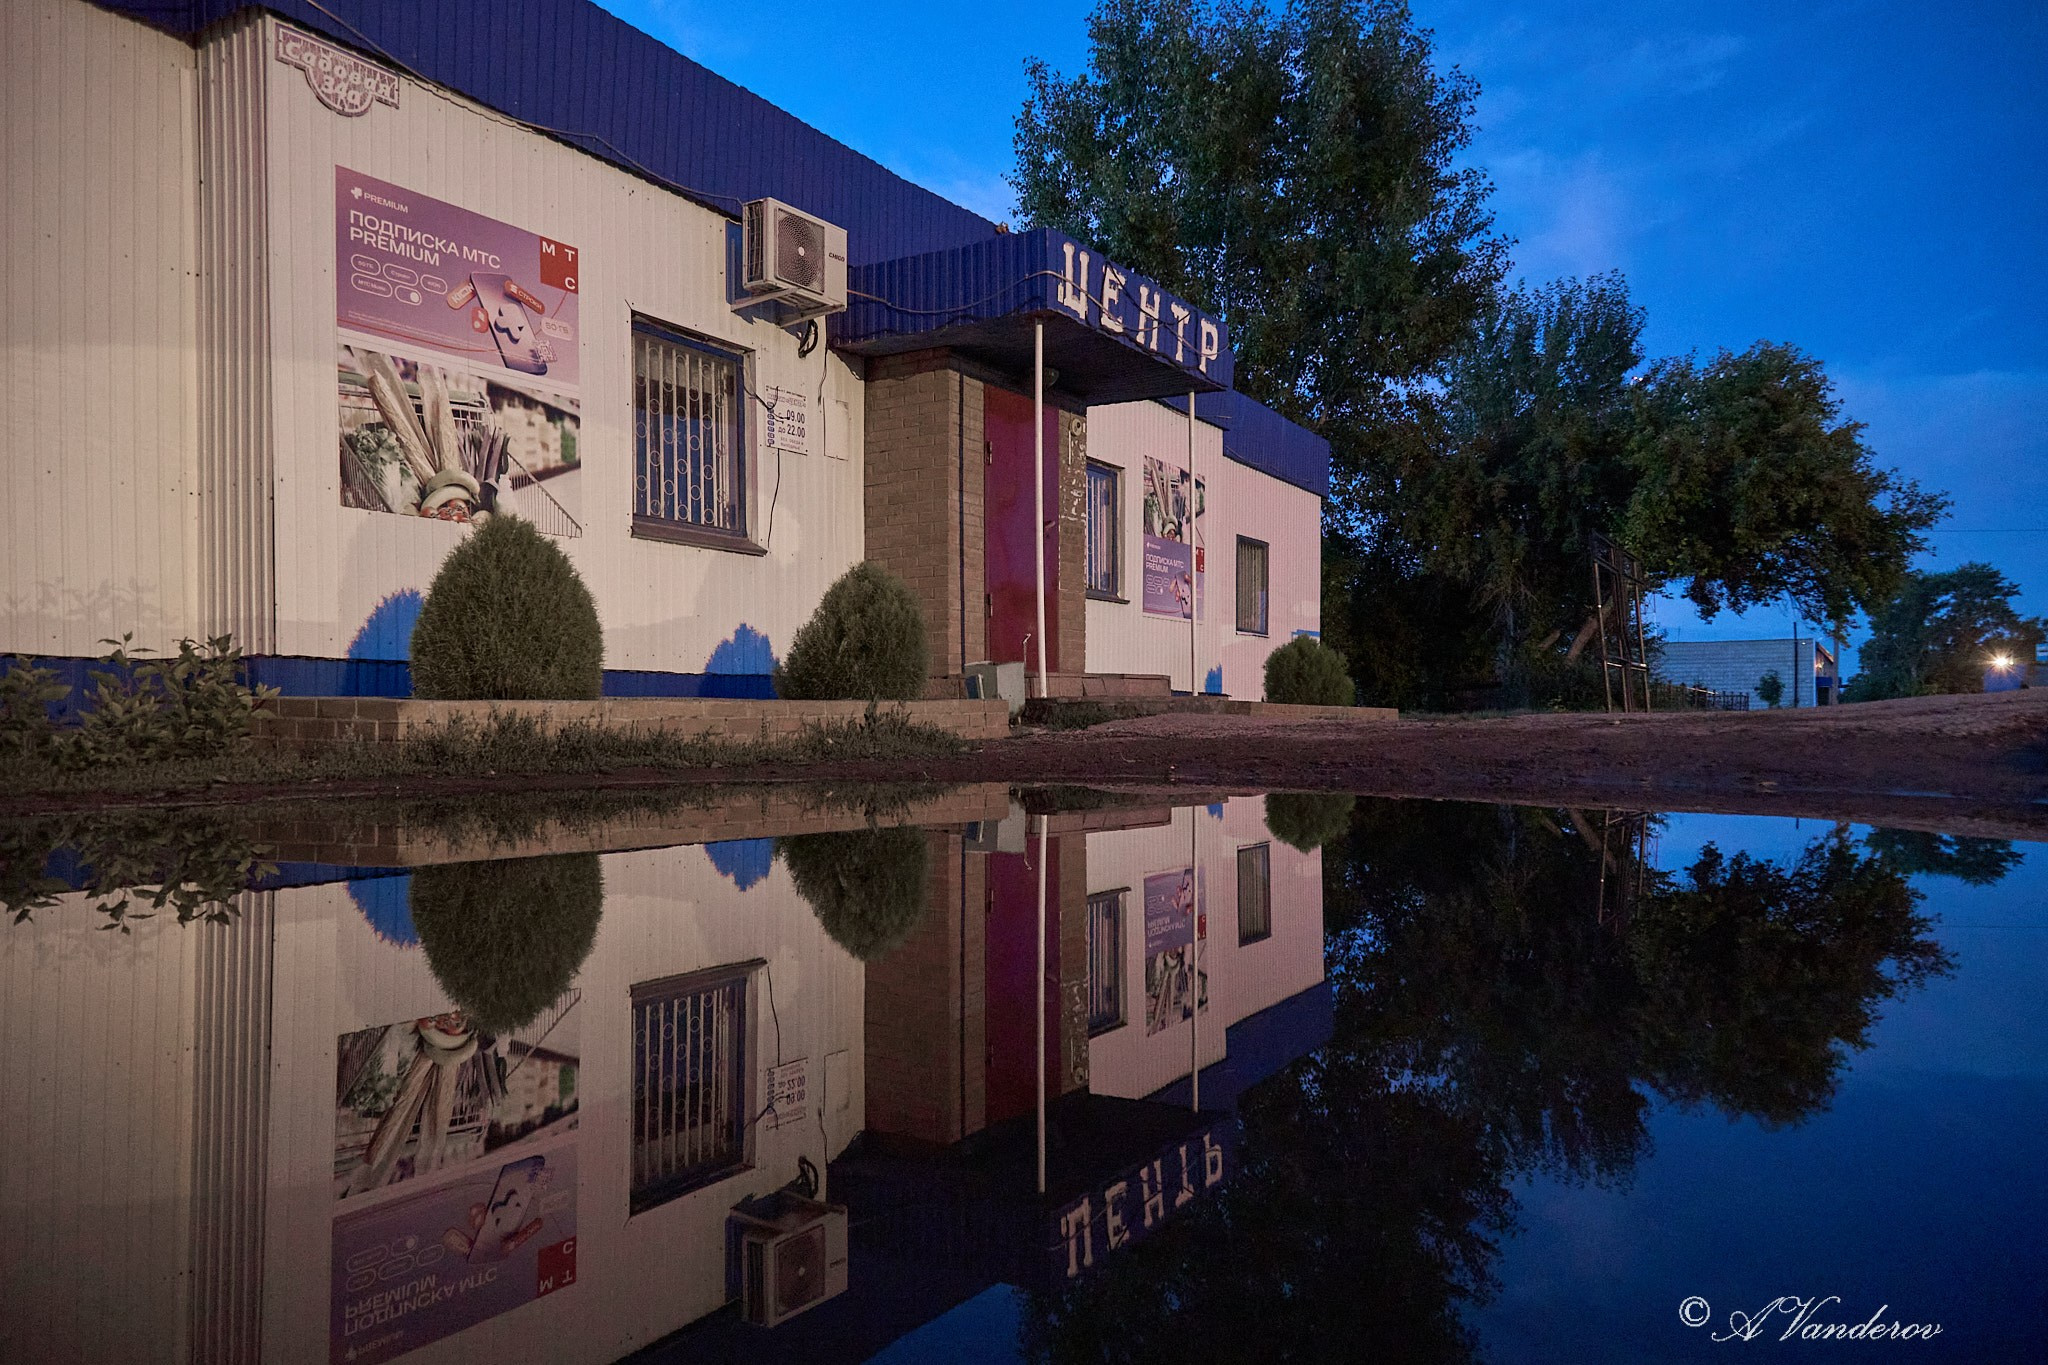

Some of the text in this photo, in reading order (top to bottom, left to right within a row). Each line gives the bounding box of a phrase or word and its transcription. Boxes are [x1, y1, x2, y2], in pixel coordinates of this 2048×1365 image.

[285, 41, 392, 100] Садовая
[363, 192, 409, 214] PREMIUM
[350, 210, 501, 269] ПОДПИСКА МТС
[350, 226, 440, 267] PREMIUM
[1057, 241, 1219, 374] ЦЕНТР
[787, 409, 805, 424] 09.00
[787, 424, 805, 438] 22.00
